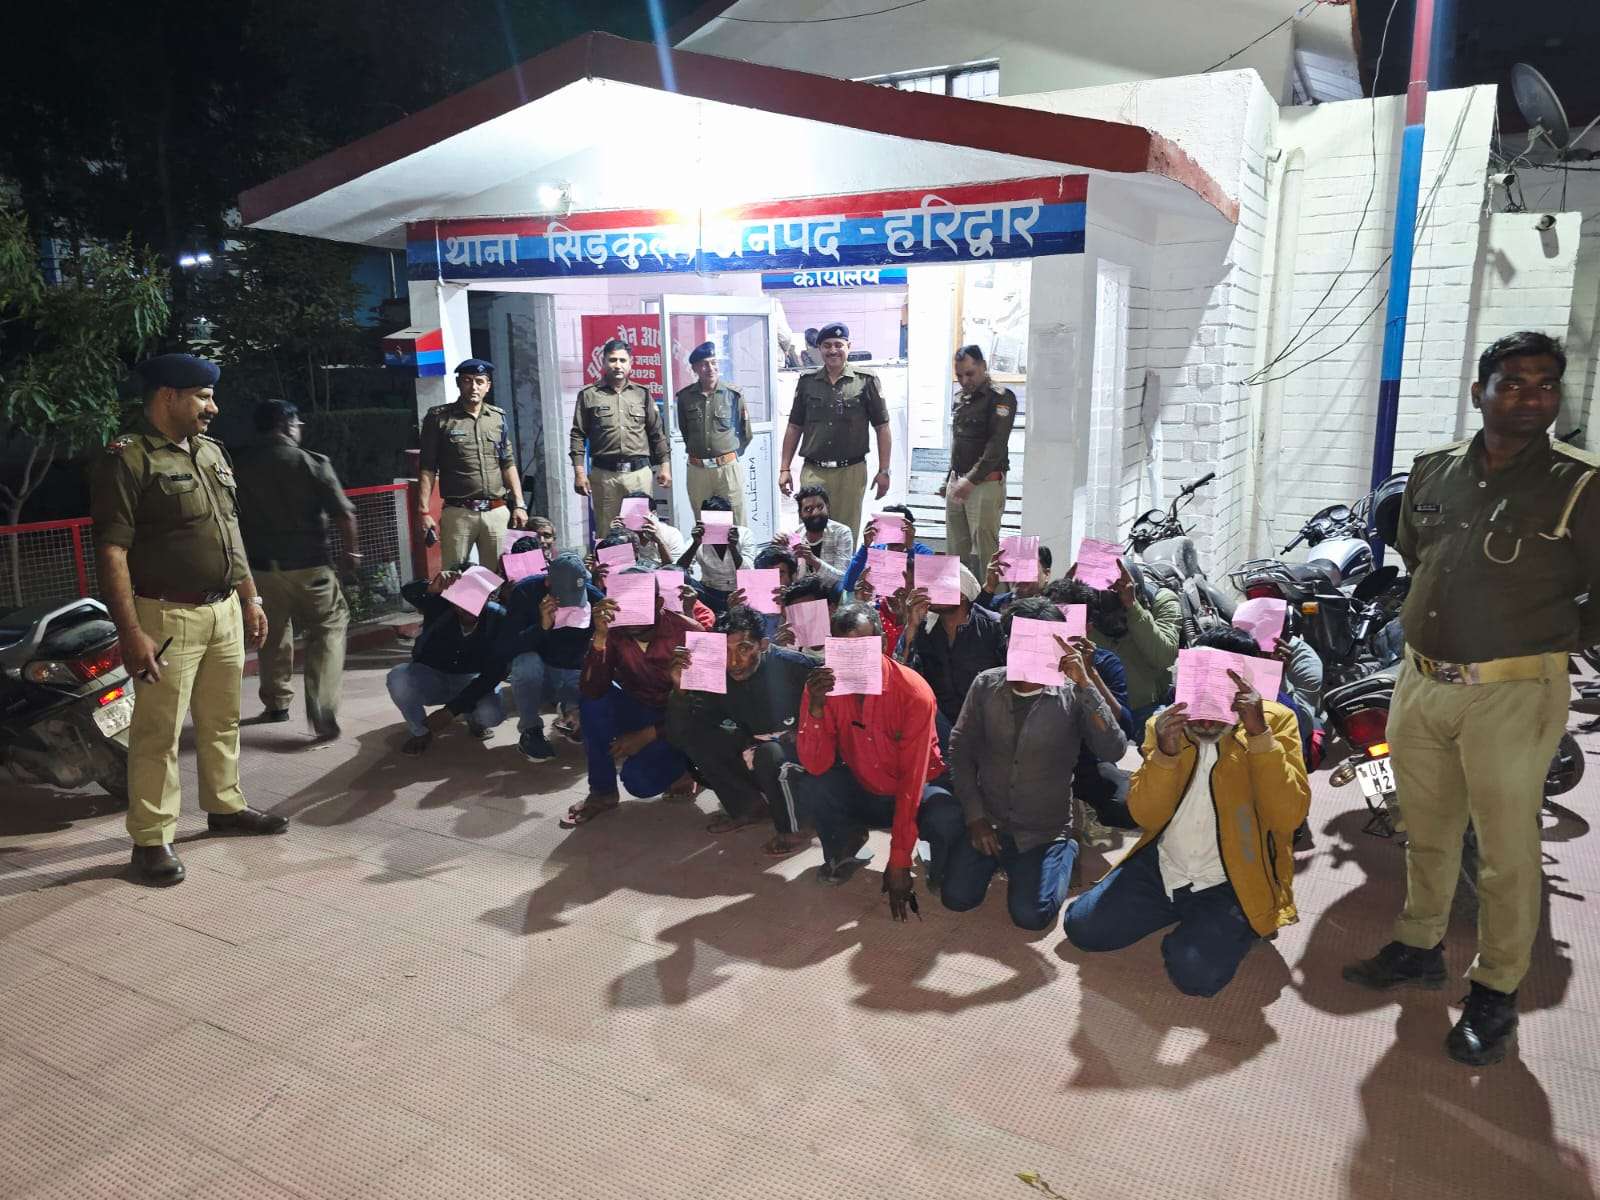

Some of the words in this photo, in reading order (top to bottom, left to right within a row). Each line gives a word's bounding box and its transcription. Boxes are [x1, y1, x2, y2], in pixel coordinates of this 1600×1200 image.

[445, 234, 519, 267] थाना
[883, 194, 1044, 257] हरिद्वार
[630, 369, 655, 379] 2026
